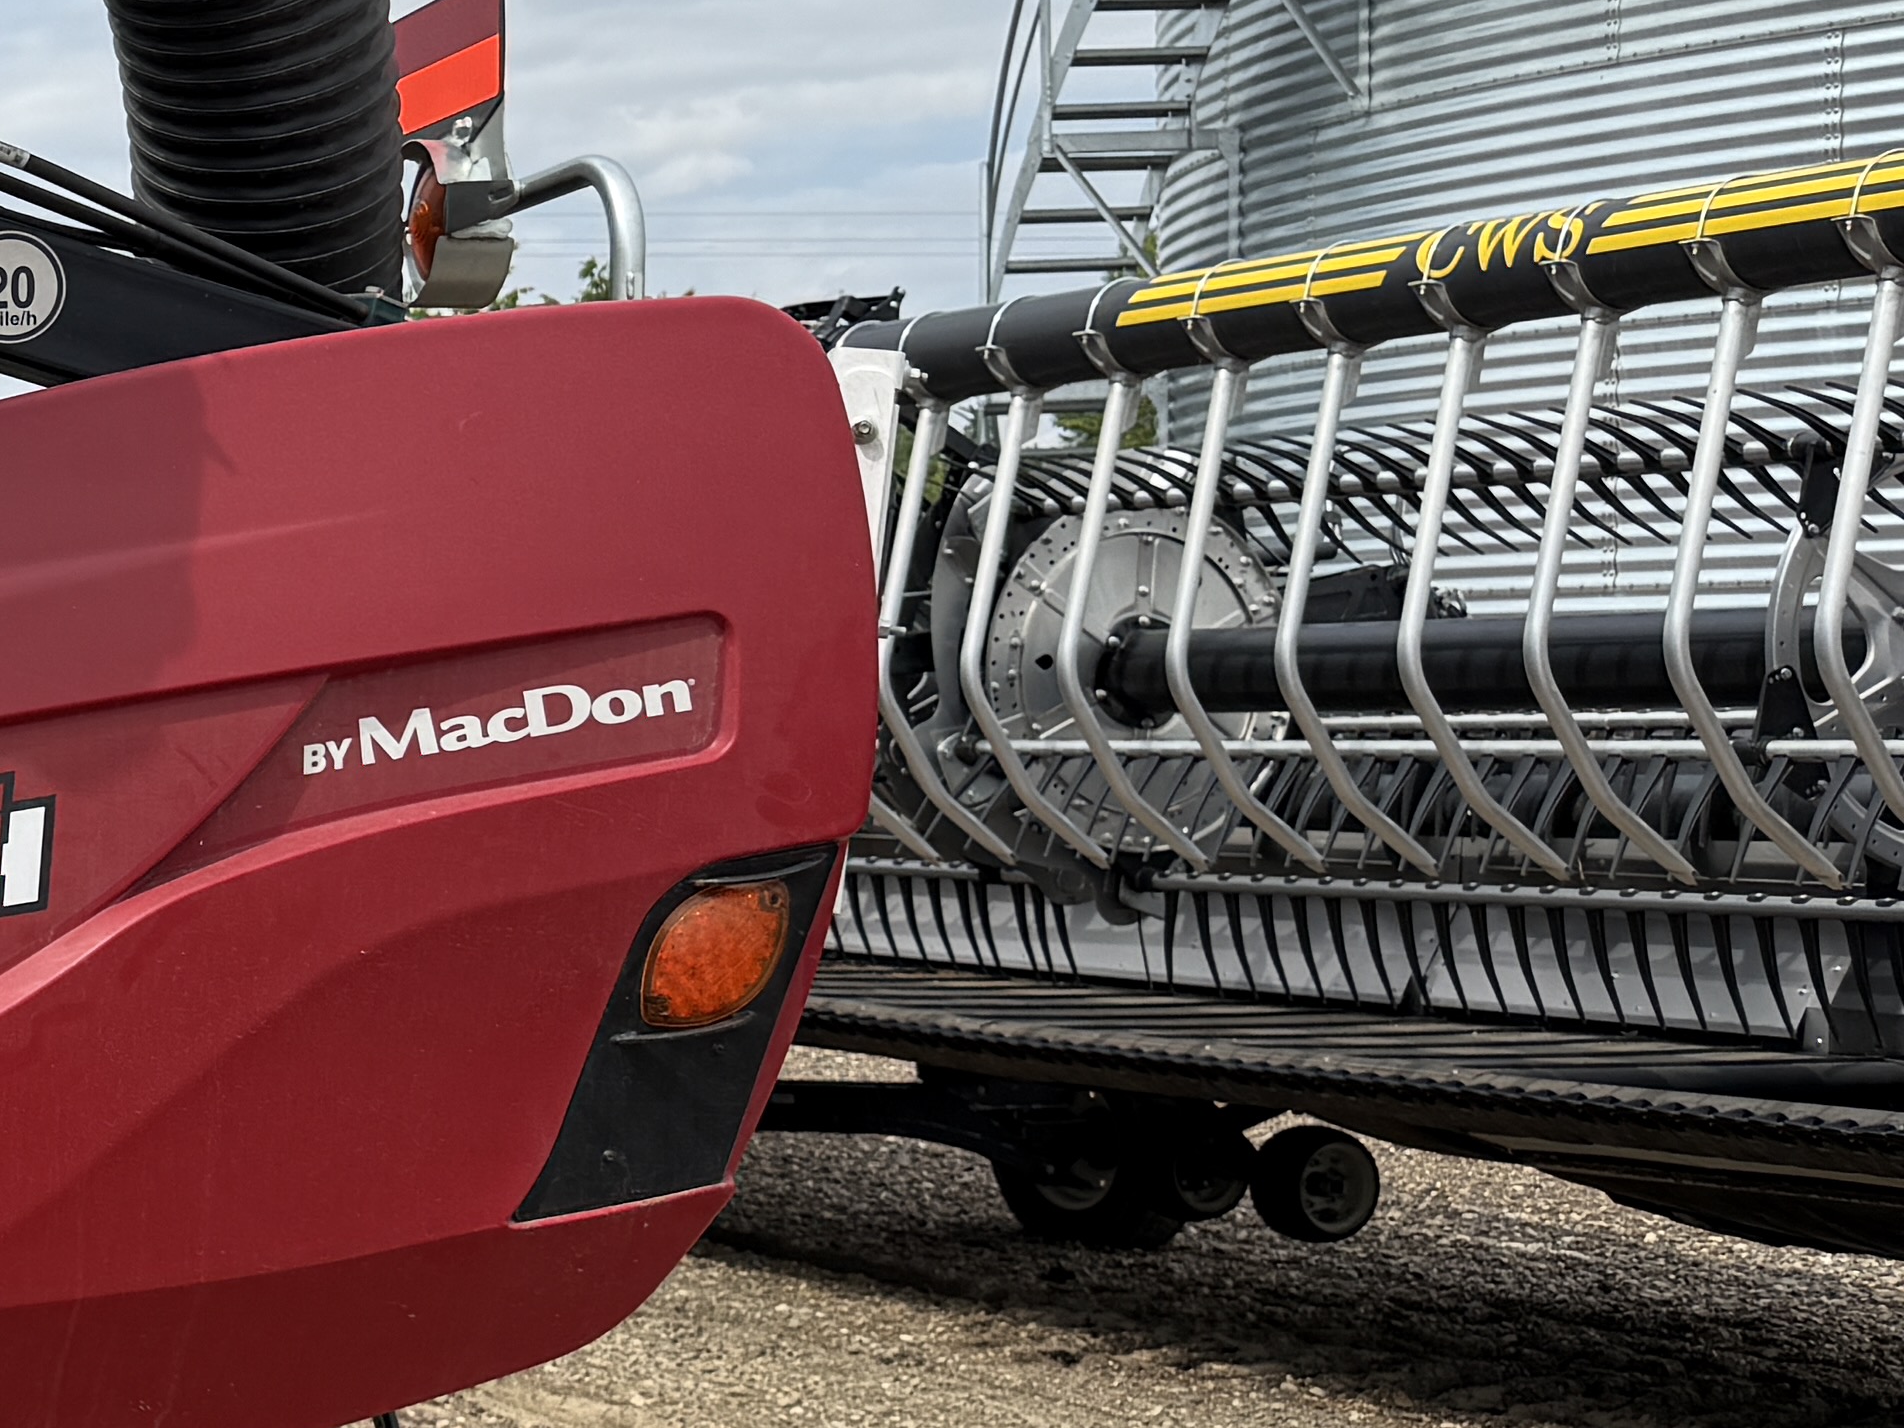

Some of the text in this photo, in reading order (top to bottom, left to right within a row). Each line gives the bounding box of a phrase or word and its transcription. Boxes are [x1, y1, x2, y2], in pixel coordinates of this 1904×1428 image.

[1416, 202, 1606, 279] CWS
[303, 679, 693, 776] BY MacDon
